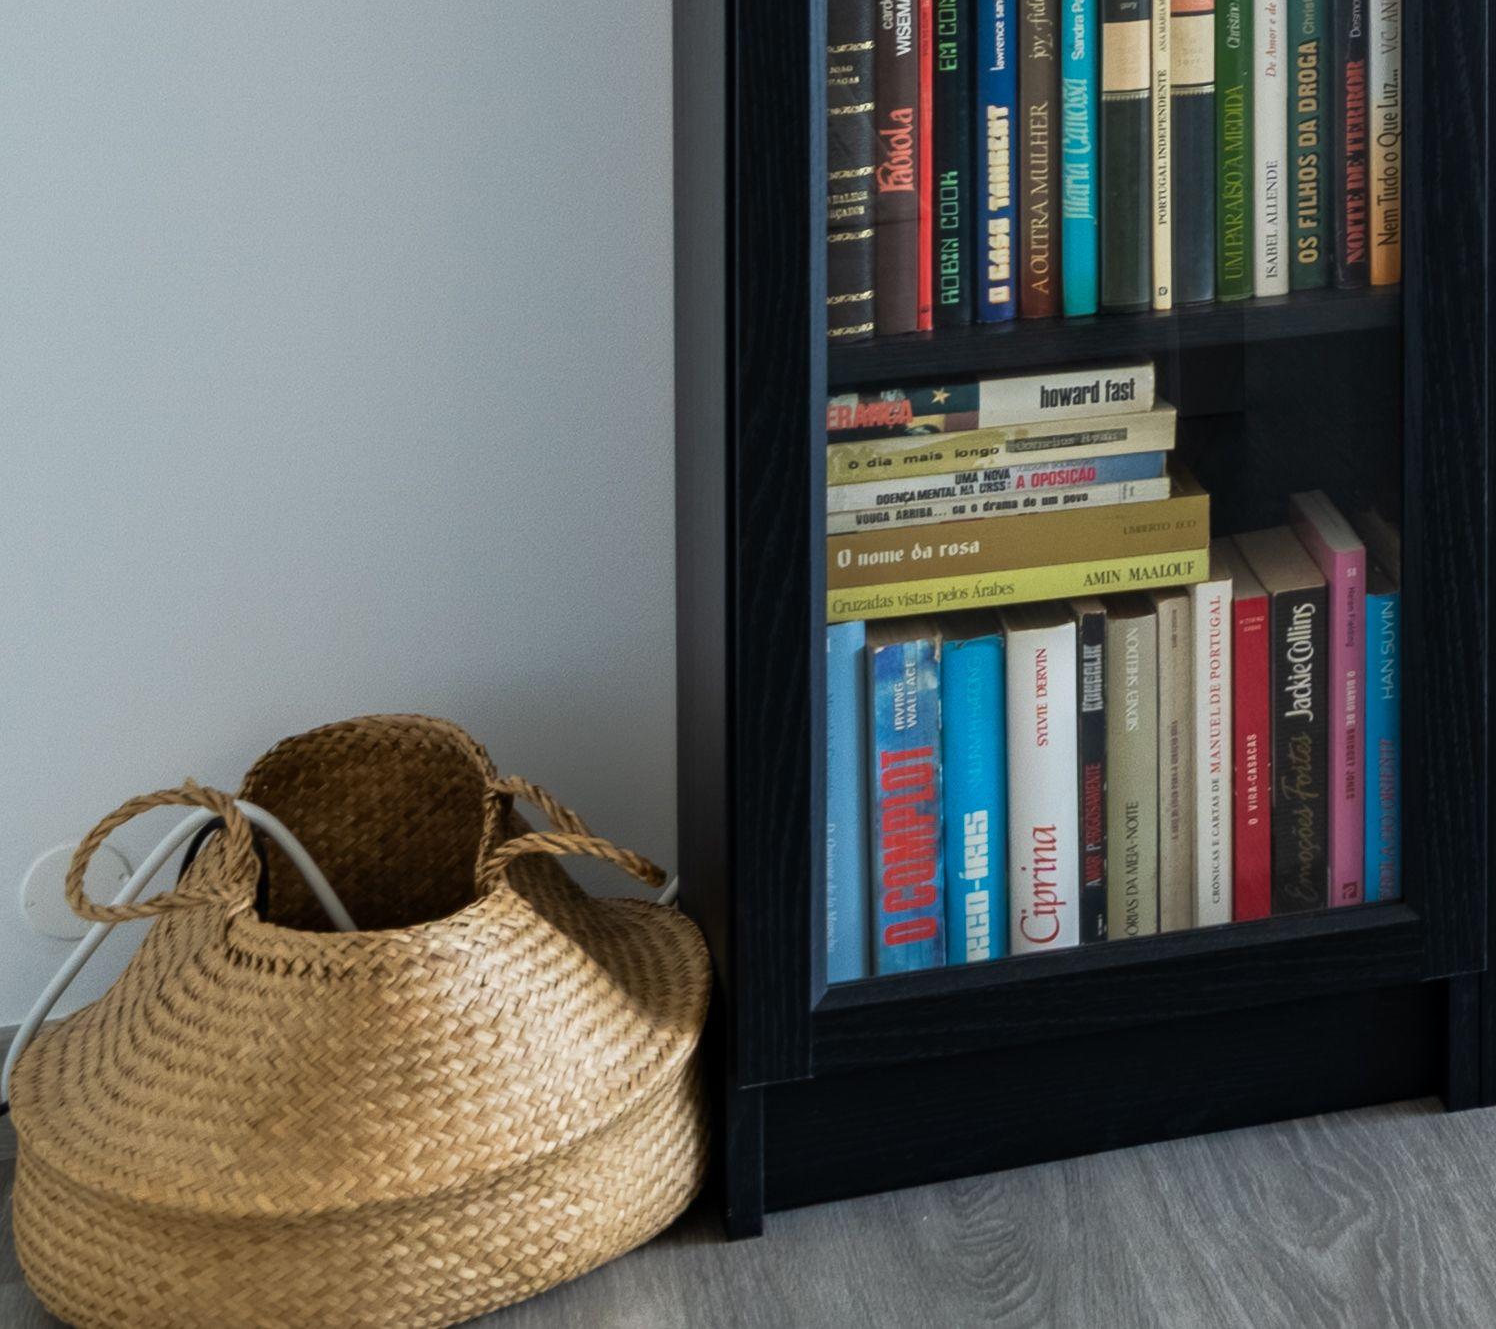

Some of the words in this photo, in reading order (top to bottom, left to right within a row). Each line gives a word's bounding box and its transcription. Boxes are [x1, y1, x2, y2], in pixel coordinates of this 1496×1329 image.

[1040, 380, 1099, 409] howard
[1105, 377, 1135, 402] fast
[837, 549, 851, 568] O
[858, 547, 904, 566] nome
[911, 541, 932, 562] da
[940, 539, 980, 558] rosa
[1020, 823, 1058, 945] Ciprina
